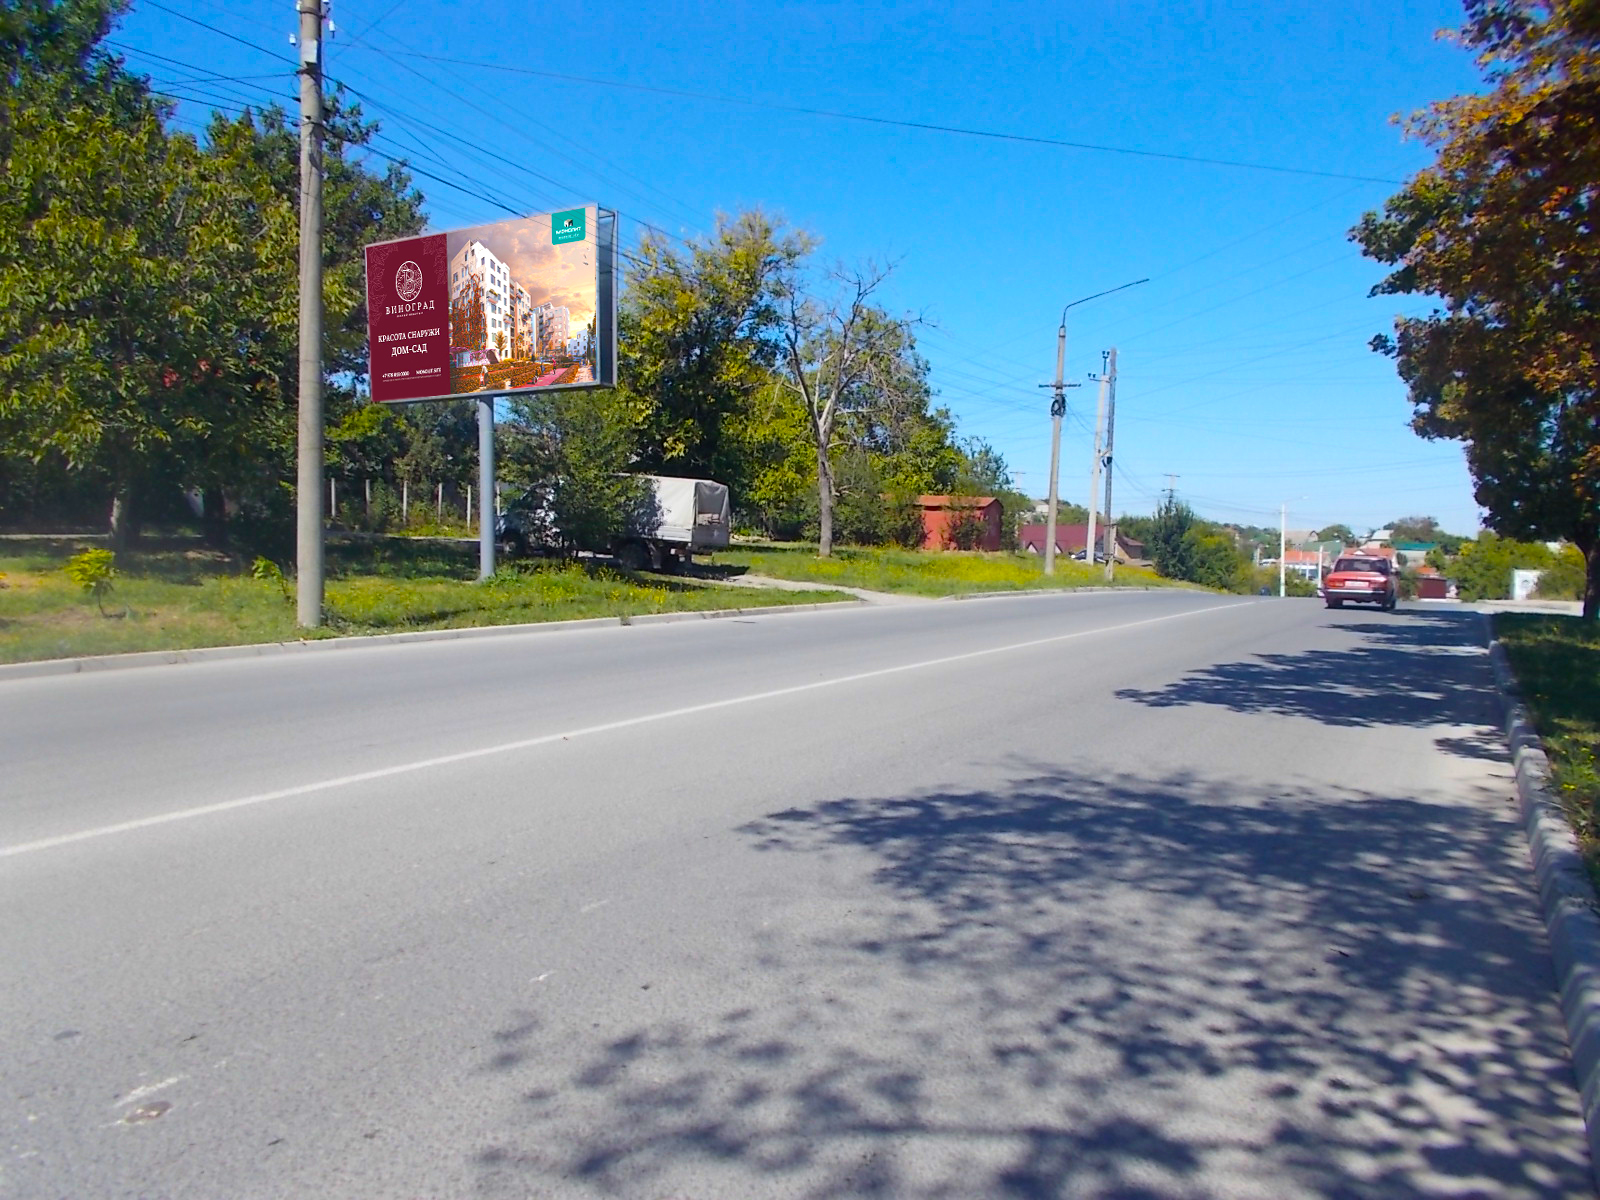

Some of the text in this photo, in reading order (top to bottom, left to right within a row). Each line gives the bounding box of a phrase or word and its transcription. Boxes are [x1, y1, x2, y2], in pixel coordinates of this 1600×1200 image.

[385, 300, 435, 315] ВИНОГРАД
[378, 327, 441, 343] КРАСОТА СНАРУЖИ
[391, 343, 428, 357] ДОМ-САД
